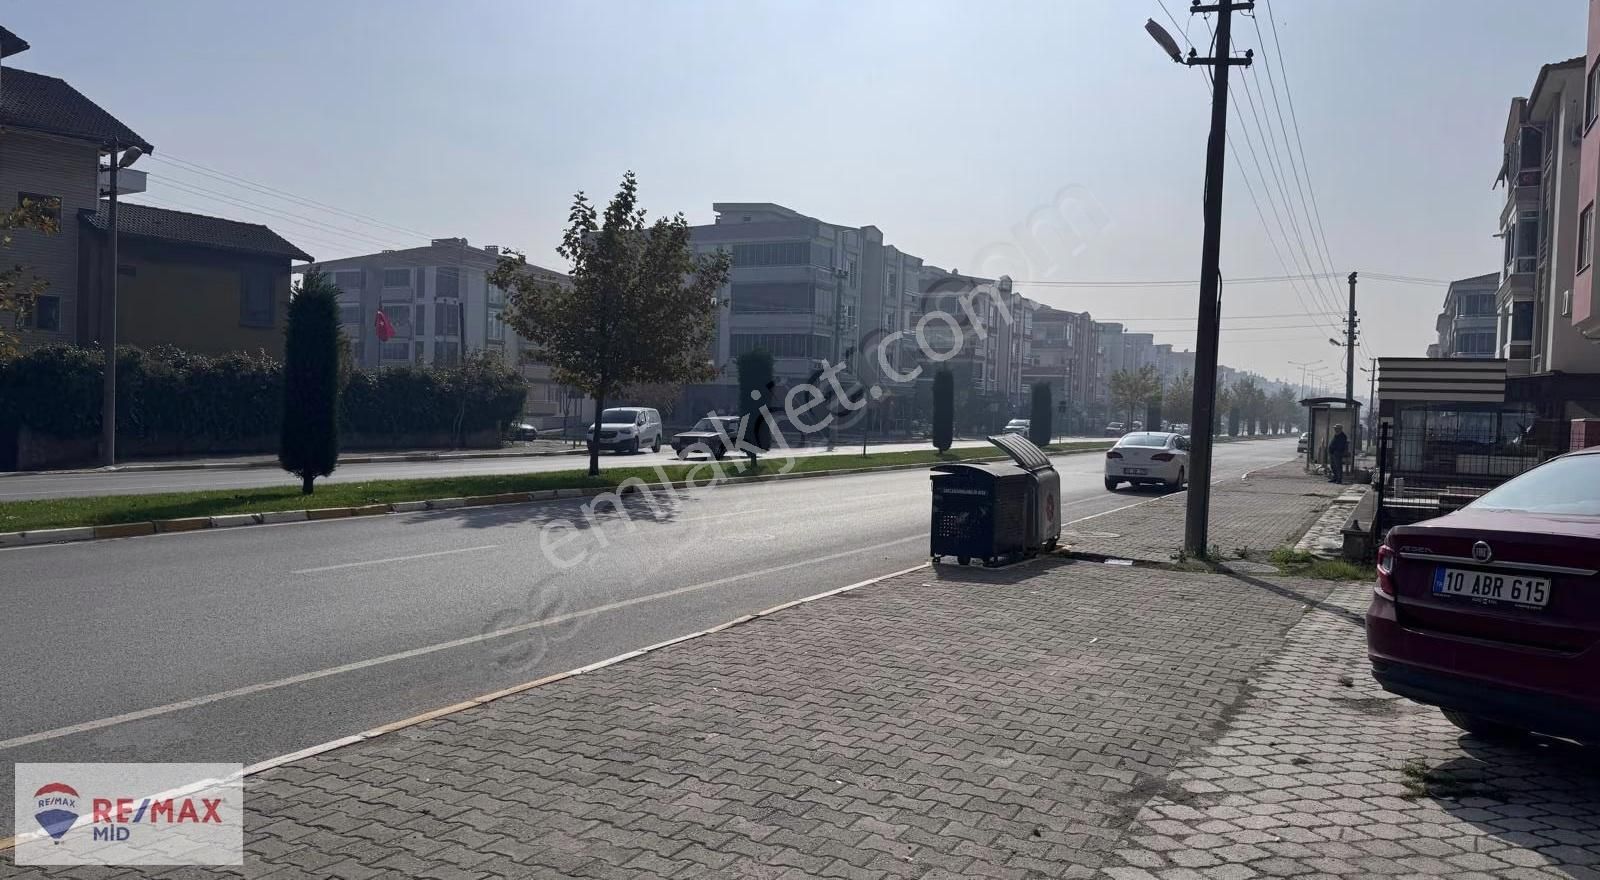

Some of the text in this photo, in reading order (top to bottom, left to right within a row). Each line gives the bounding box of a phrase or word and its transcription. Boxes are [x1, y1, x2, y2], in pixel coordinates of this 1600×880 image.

[1446, 571, 1464, 592] 10
[1471, 574, 1504, 598] ABR
[1511, 579, 1545, 603] 615
